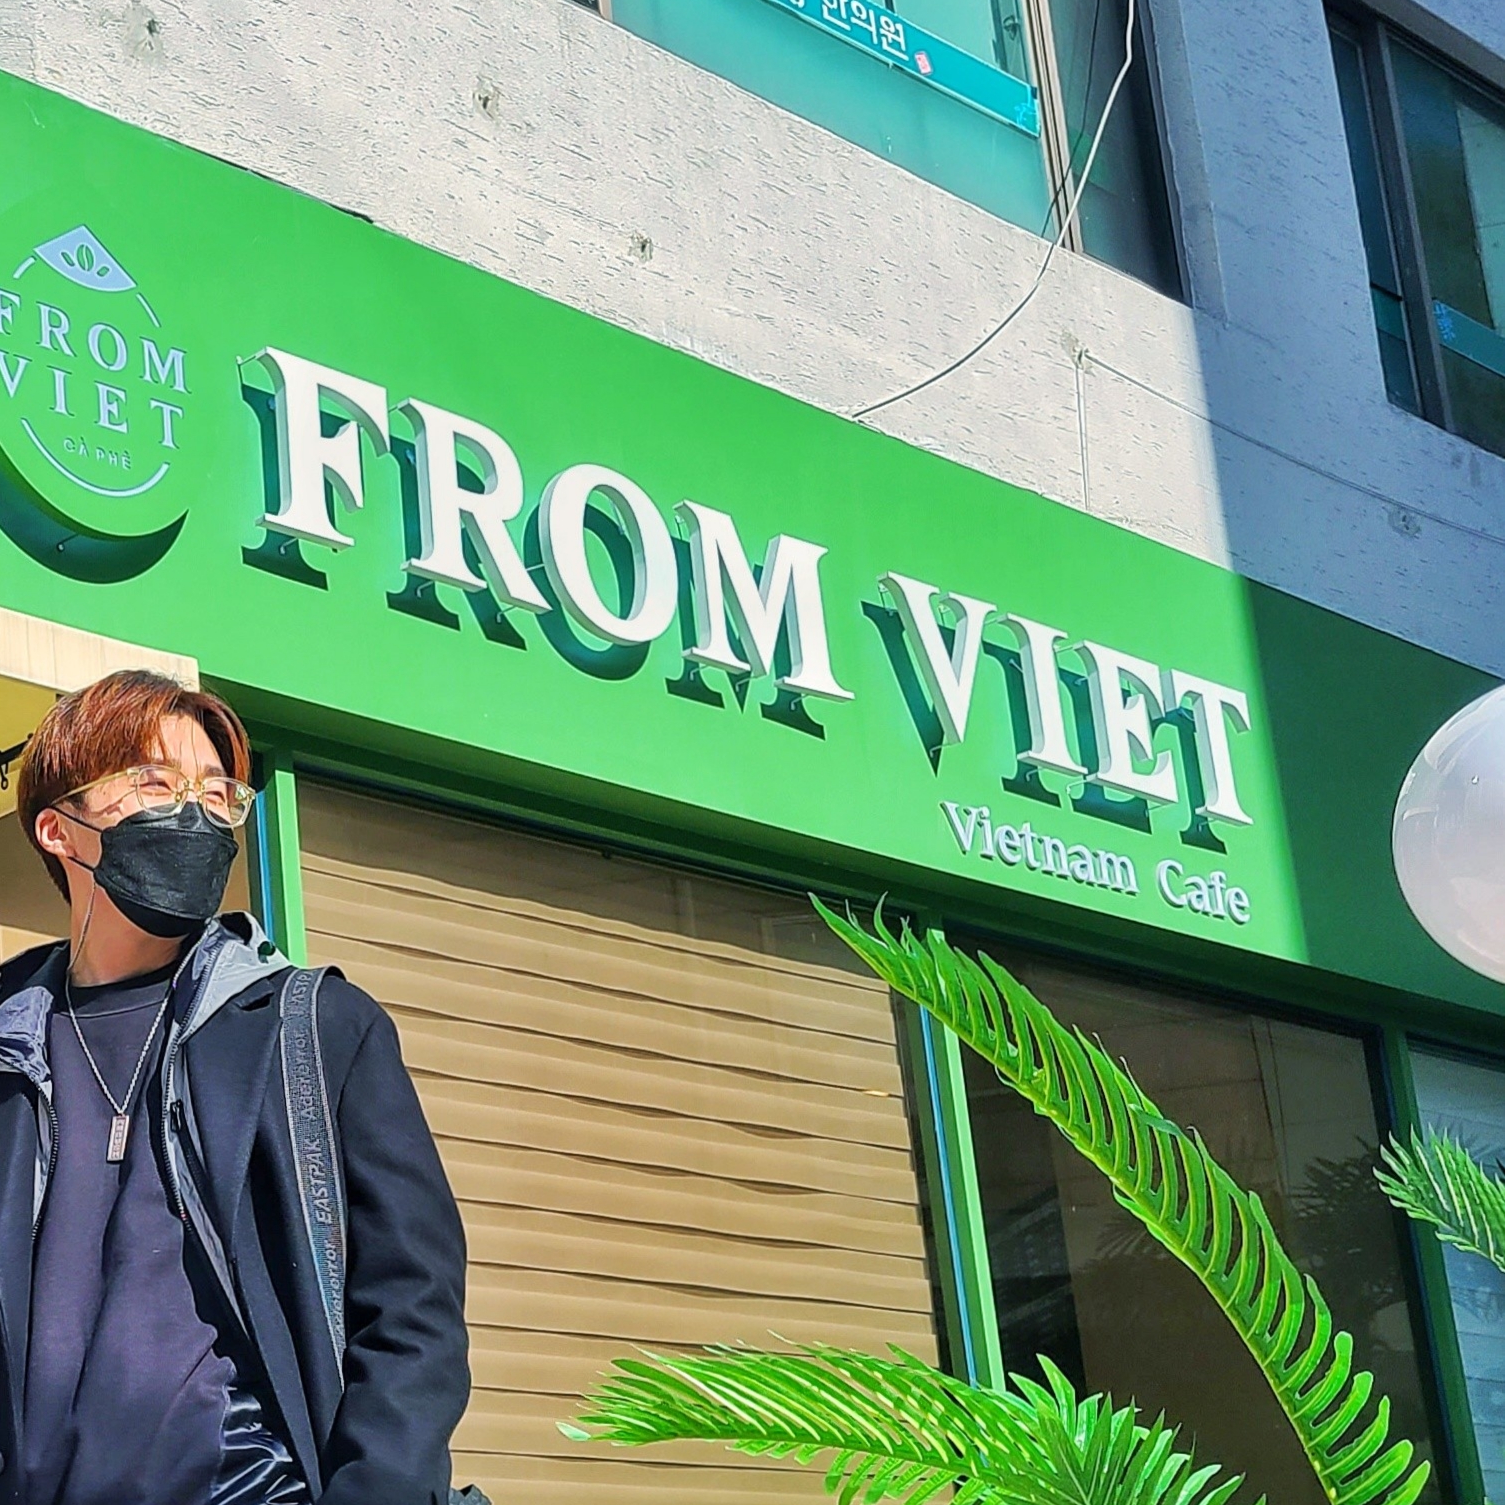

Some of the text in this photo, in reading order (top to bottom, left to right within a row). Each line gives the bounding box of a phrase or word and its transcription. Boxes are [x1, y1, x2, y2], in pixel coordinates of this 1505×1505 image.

[254, 346, 1256, 827] FROM VIET
[939, 800, 1251, 925] Vietnam Cafe
[304, 1138, 333, 1224] EASTPAK
